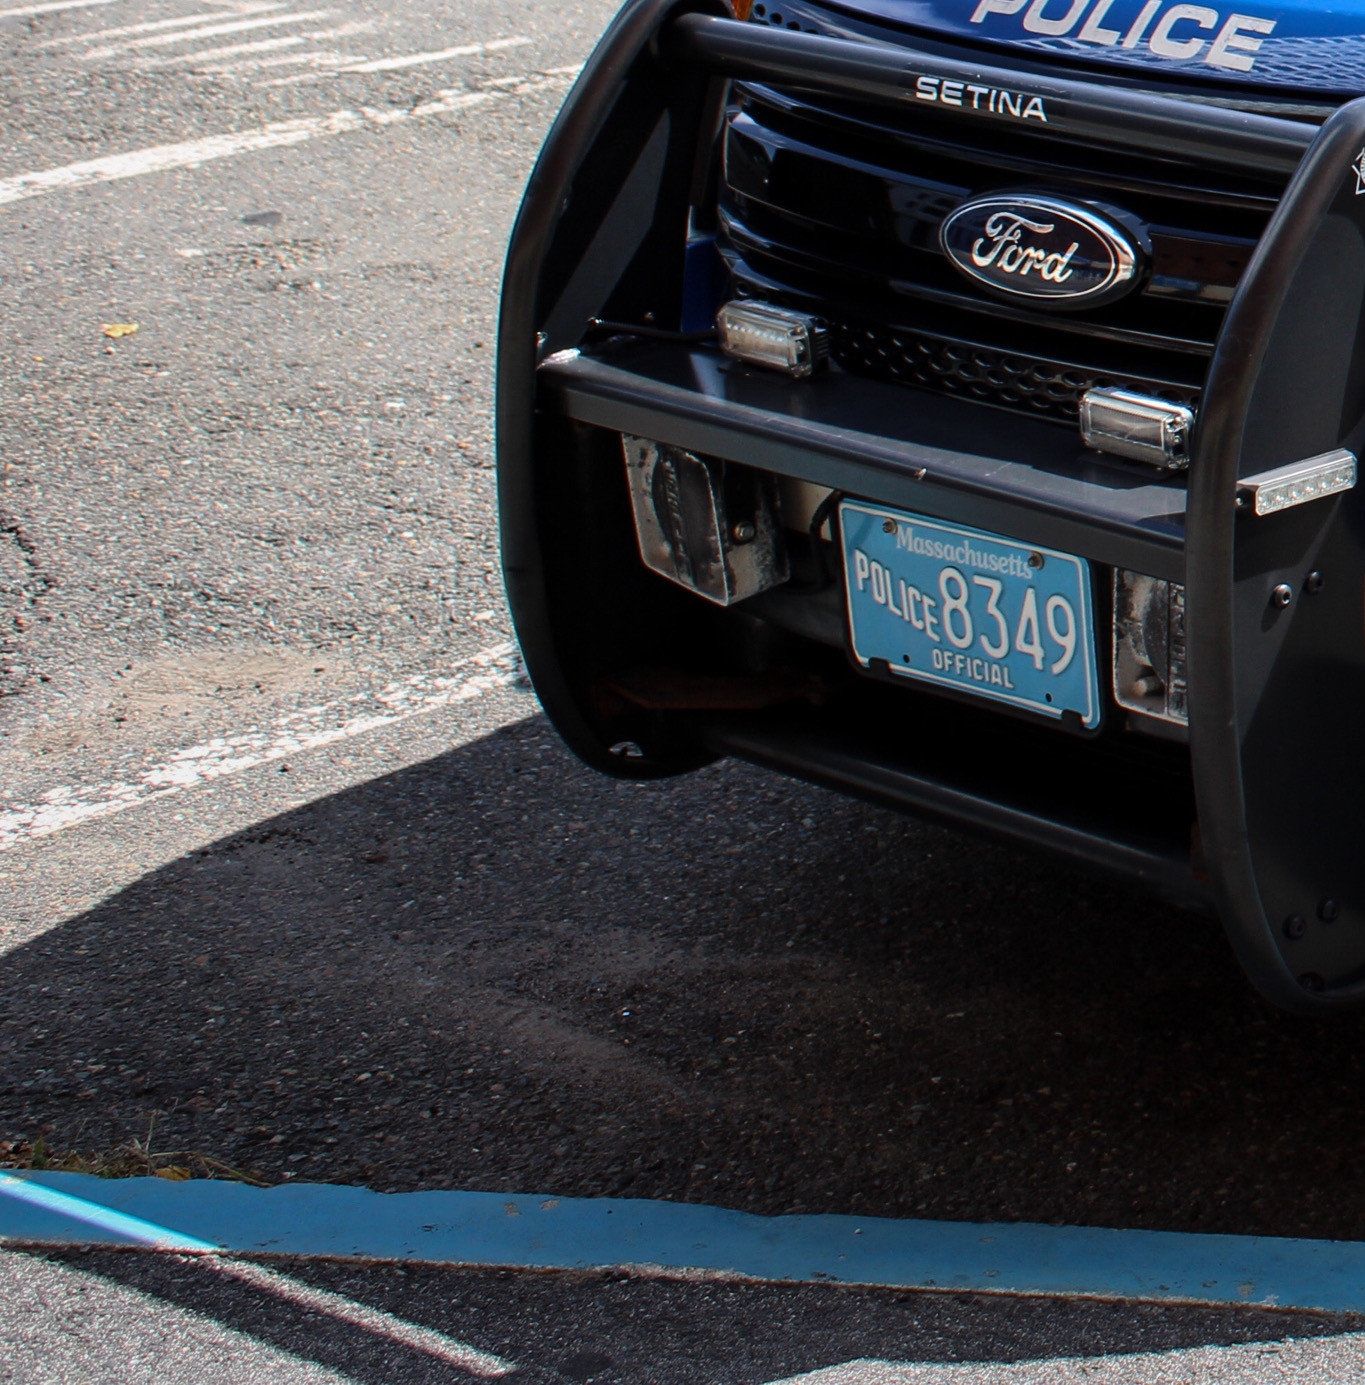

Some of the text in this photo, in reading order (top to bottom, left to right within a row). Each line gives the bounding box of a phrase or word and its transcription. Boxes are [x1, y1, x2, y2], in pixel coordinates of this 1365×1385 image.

[915, 76, 1048, 122] SETINA
[971, 211, 1079, 283] Ford
[896, 524, 1033, 580] Massachusetts
[855, 548, 941, 643] POLICE
[939, 566, 1076, 676] 8349
[932, 648, 1015, 690] OFFICIAL
